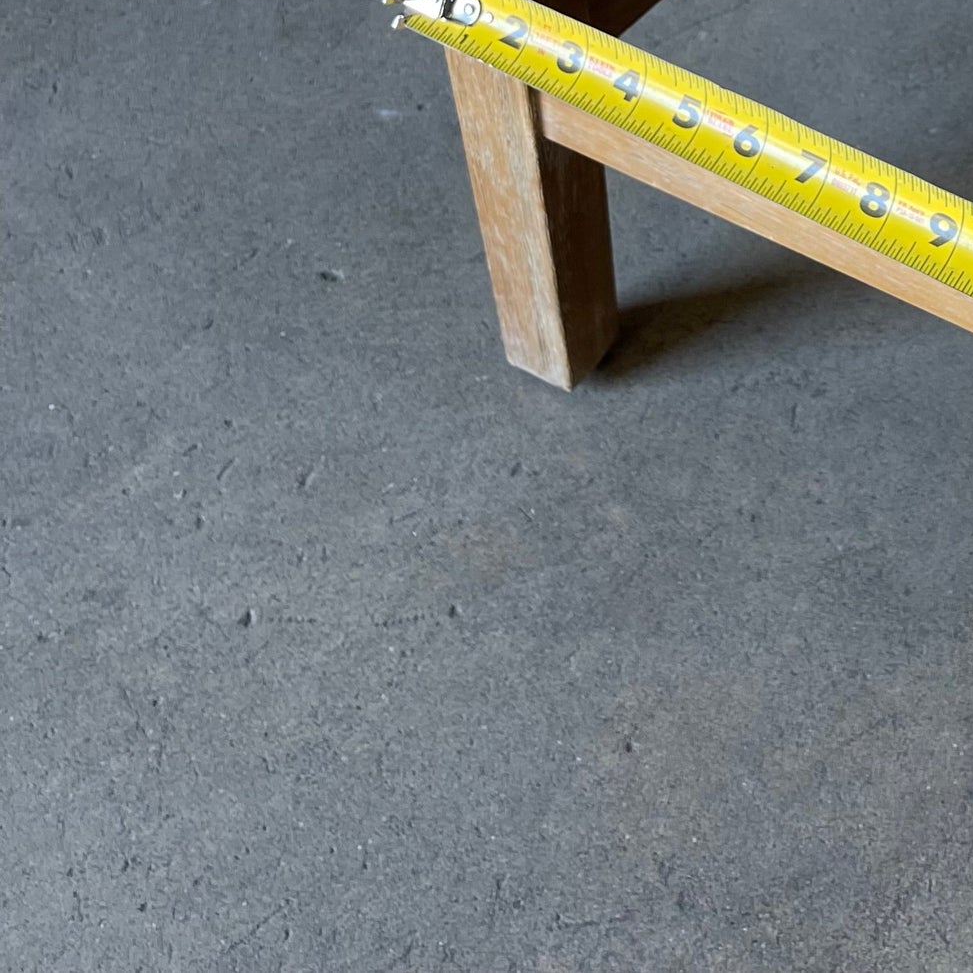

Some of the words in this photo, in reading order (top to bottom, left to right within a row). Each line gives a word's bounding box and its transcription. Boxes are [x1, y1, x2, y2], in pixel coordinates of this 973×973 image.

[459, 34, 468, 45] 1
[498, 16, 528, 50] 2
[557, 41, 585, 74] 3
[613, 69, 640, 102] 4
[672, 94, 701, 129] 5
[733, 125, 760, 157] 6
[794, 149, 828, 184] 7
[860, 182, 890, 218] 8
[929, 212, 958, 247] 9
